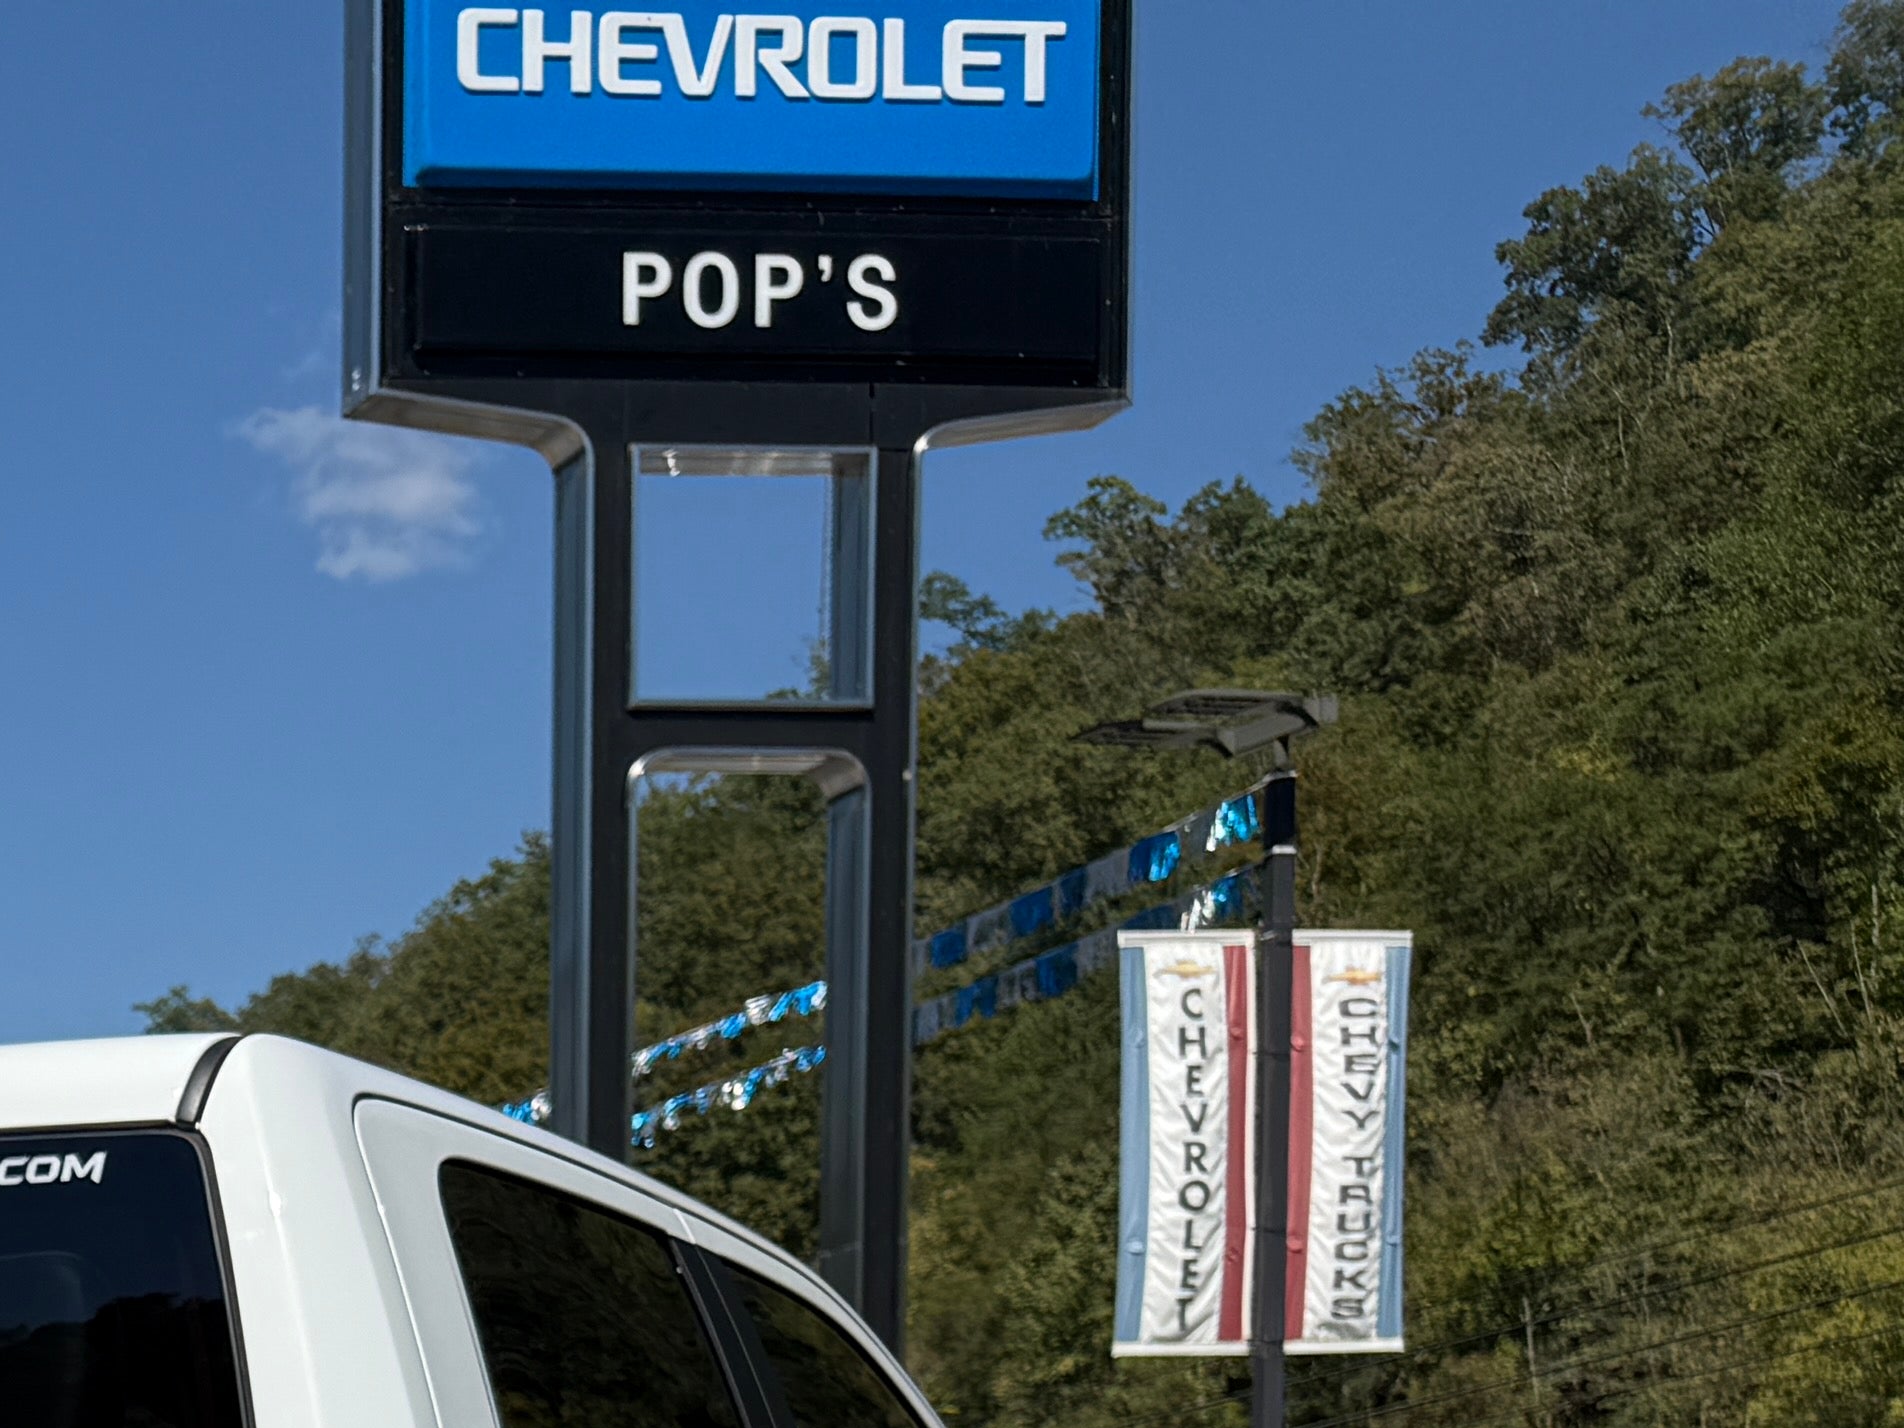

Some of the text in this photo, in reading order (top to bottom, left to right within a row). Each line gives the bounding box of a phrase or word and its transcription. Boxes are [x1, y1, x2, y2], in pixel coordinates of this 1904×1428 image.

[455, 8, 1067, 103] CHEVROLET
[621, 251, 899, 331] POP'S
[1176, 987, 1211, 1332] CHEVROLET
[1332, 998, 1379, 1321] CHEVY TRUCKS
